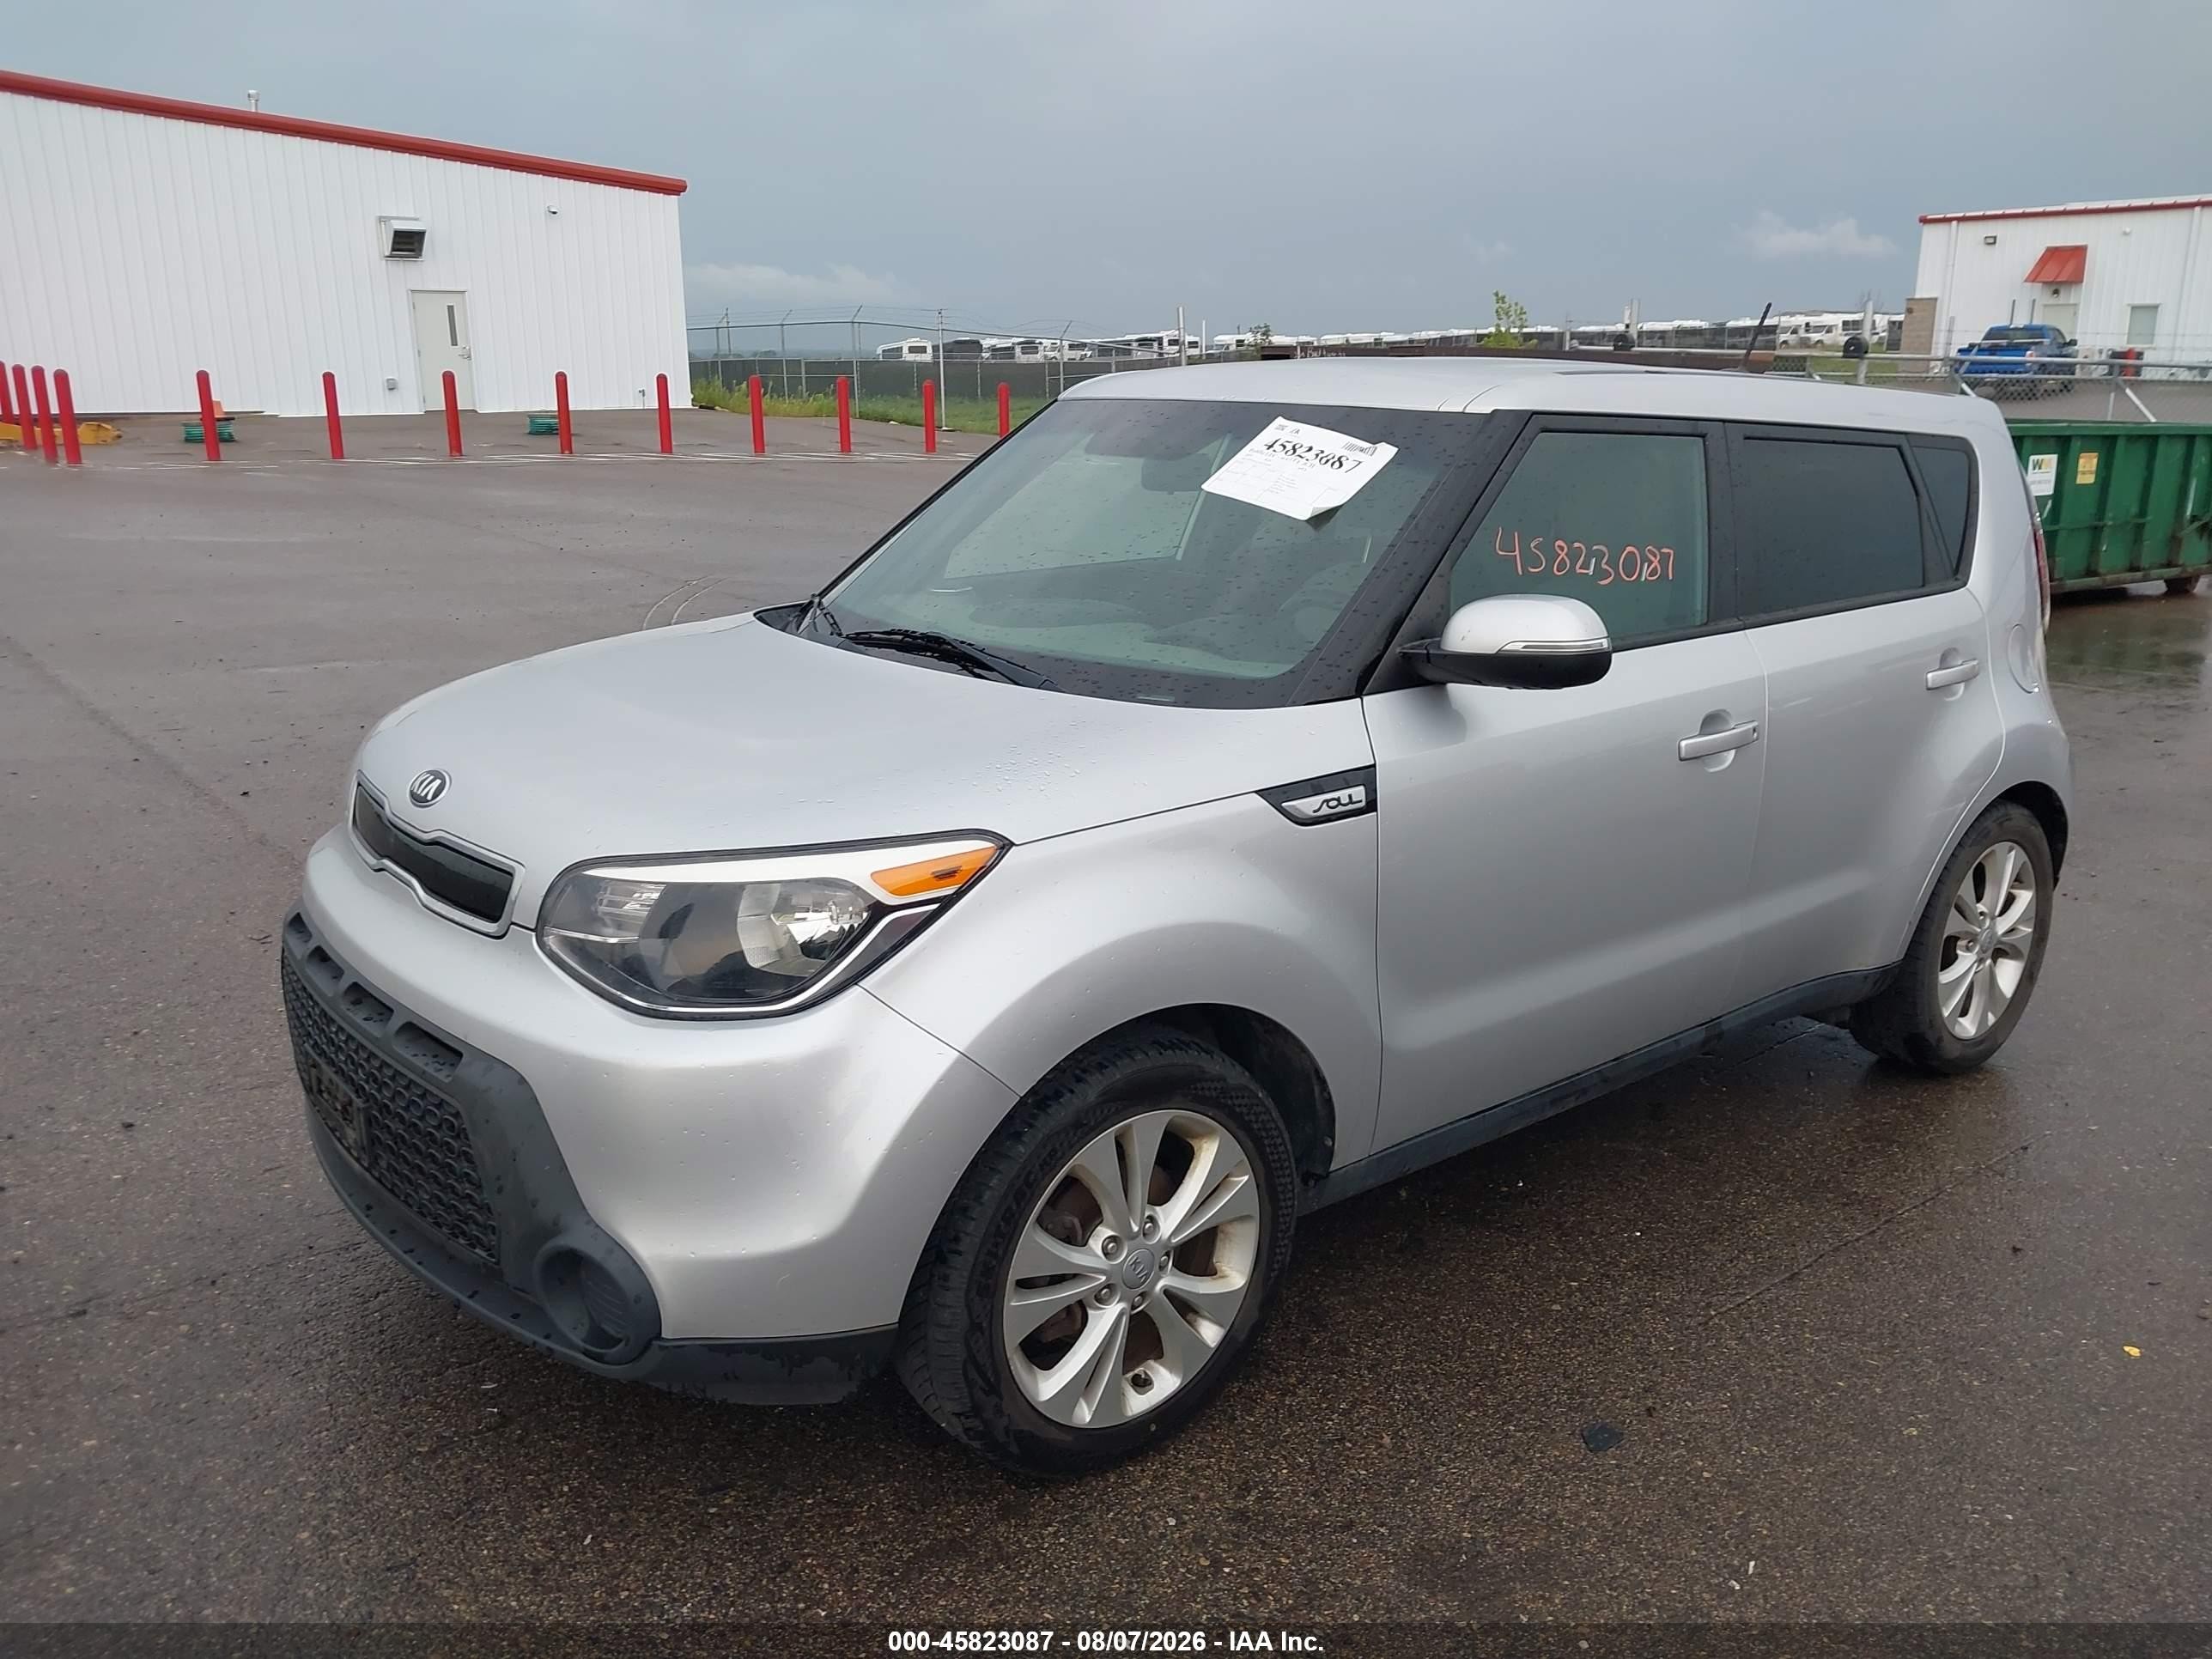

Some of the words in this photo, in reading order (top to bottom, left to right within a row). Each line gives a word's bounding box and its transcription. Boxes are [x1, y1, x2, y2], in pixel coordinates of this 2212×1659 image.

[1264, 438, 1363, 473] 45823087
[1496, 526, 1674, 585] 45823087
[1312, 793, 1363, 813] SOUL
